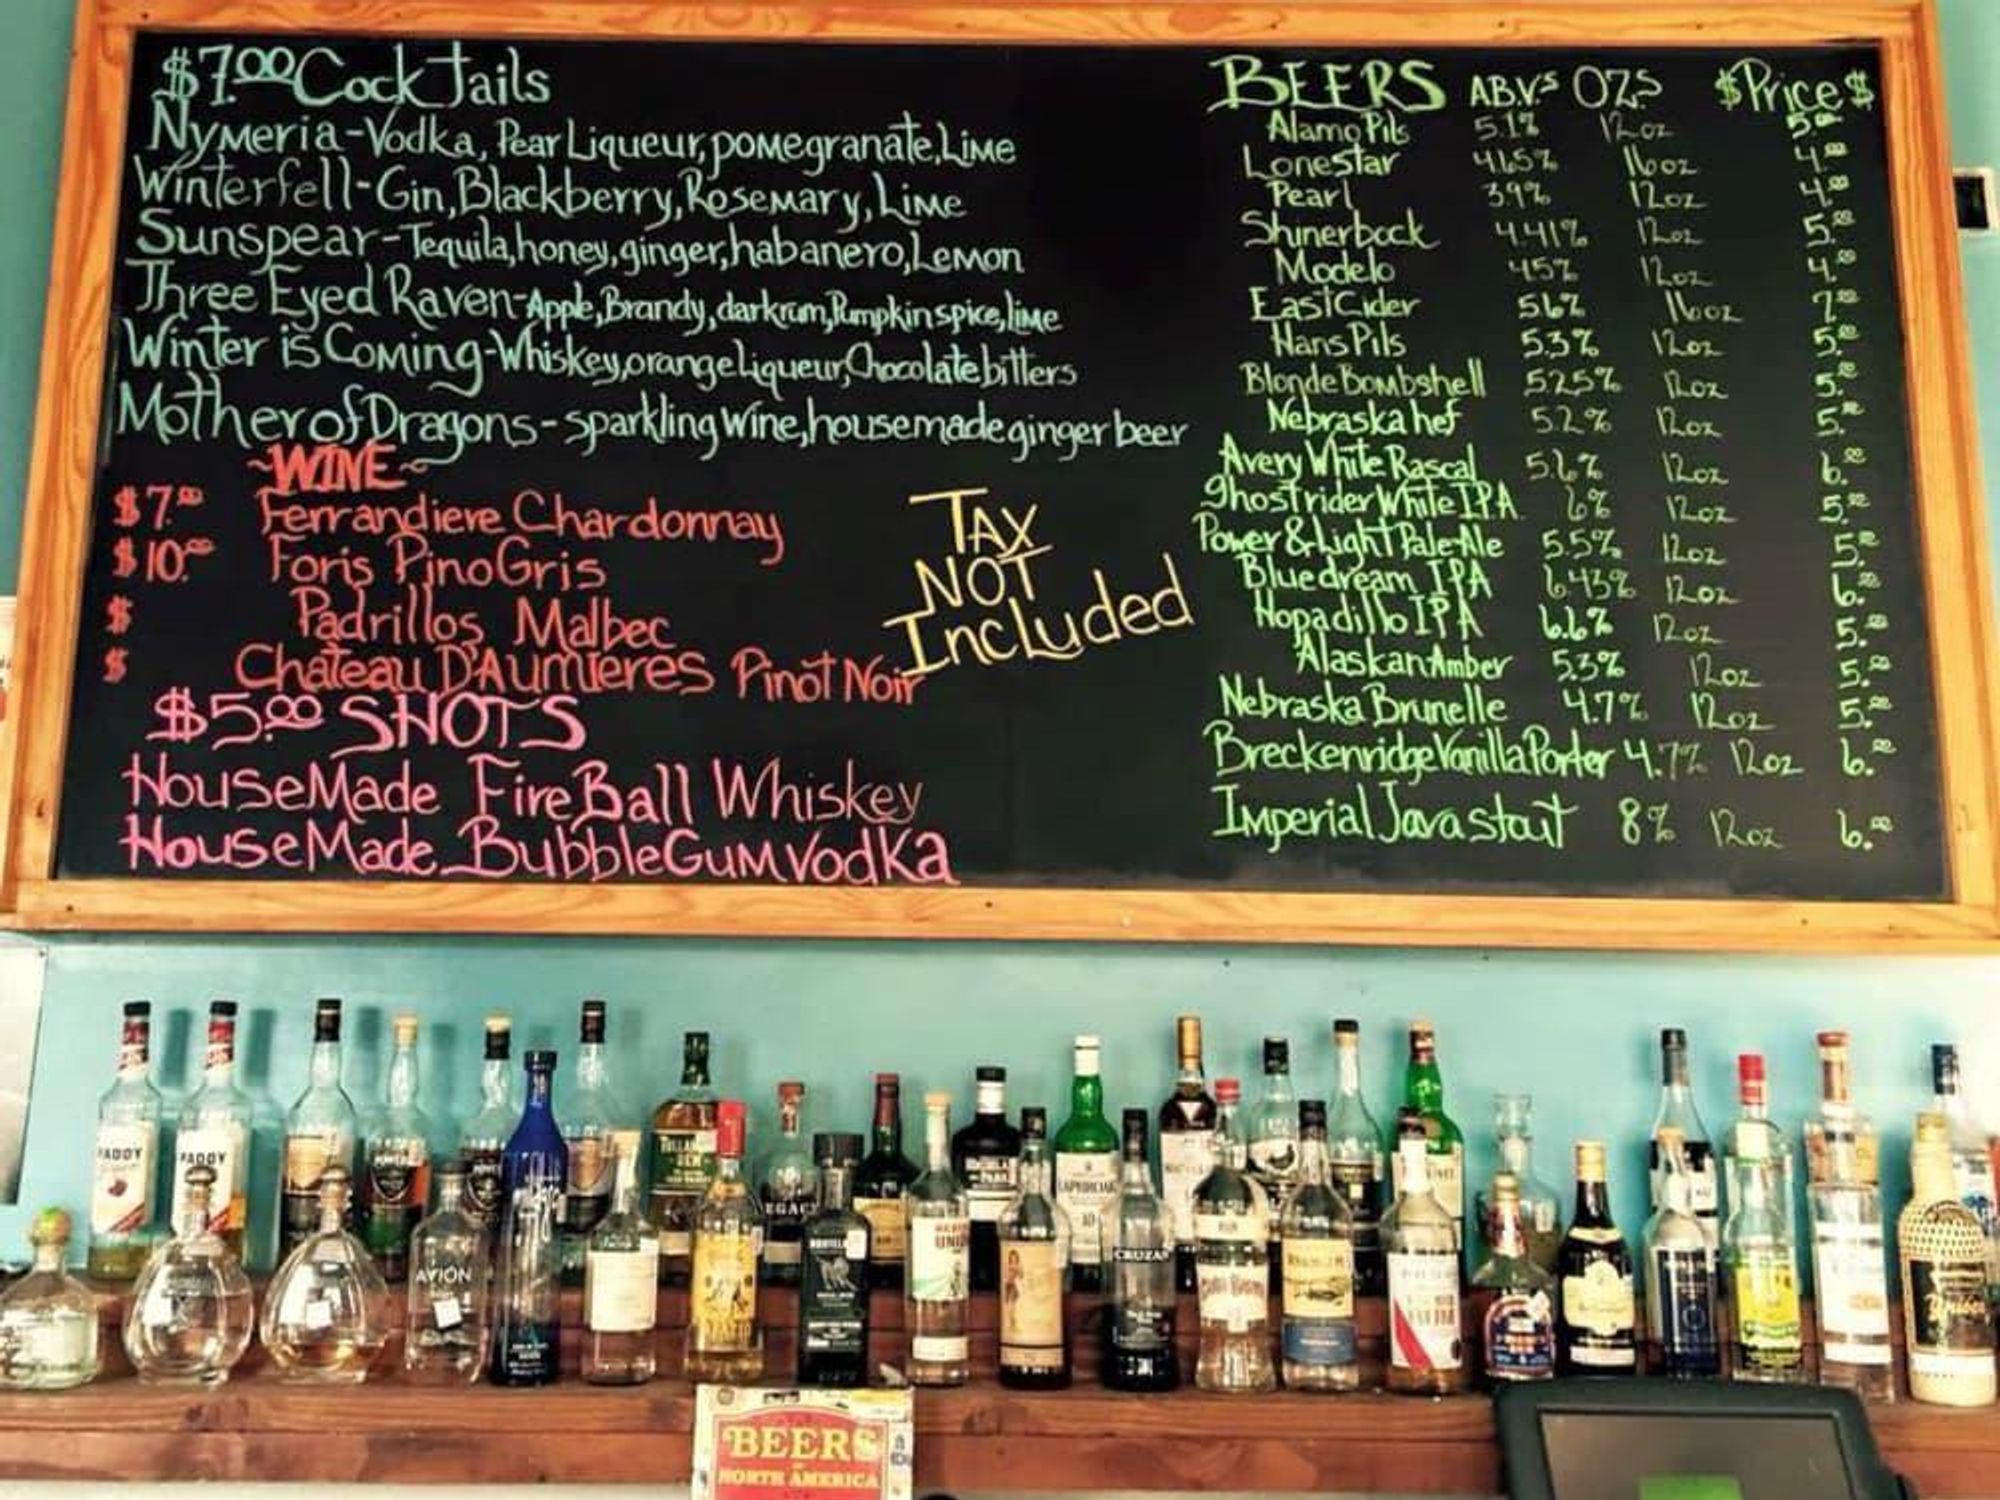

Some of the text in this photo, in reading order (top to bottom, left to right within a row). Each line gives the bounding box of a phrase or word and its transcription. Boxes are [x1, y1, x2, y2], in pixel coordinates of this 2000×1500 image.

[1206, 53, 1448, 112] BEERS
[497, 117, 561, 158] Pear
[1267, 109, 1361, 143] Alamo
[1364, 109, 1411, 145] Pils
[1243, 143, 1402, 178] Lonestar
[874, 172, 967, 224] Lime
[1266, 178, 1355, 211] Pearl
[1274, 246, 1396, 286] Modelo
[125, 259, 258, 318] Three
[267, 262, 380, 332] Eyed
[122, 318, 269, 369] Winter
[281, 326, 320, 369] is
[116, 372, 299, 447] Mother
[309, 384, 364, 441] of
[564, 391, 718, 460] sparkling
[1007, 420, 1109, 462] ginger
[1113, 410, 1189, 448] beer
[1266, 395, 1407, 434] Nebraska
[1410, 396, 1464, 436] hef
[1219, 432, 1302, 480] Avery
[1305, 431, 1386, 479] White
[1385, 442, 1478, 482] Rascal
[1377, 475, 1454, 519] White
[512, 491, 784, 564] Chardonnay
[1192, 511, 1282, 552] Power
[1284, 515, 1316, 557] &
[268, 535, 375, 587] Foris
[387, 535, 496, 588] Pino
[496, 535, 606, 591] Gris
[915, 544, 1054, 615] NOT
[290, 585, 675, 650] Padrillos Malbec
[235, 641, 427, 692] Chateau
[731, 647, 833, 703] Pinot
[844, 654, 926, 704] Noir
[1296, 631, 1430, 678] Alaskan
[1428, 643, 1513, 680] Amber
[329, 692, 587, 758] SHOTS
[1219, 673, 1363, 725] Nebraska
[1362, 680, 1508, 728] Brunelle
[712, 758, 924, 825] Whiskey
[1210, 782, 1375, 853] Imperial
[1378, 780, 1466, 844] Java
[416, 1266, 471, 1283] AVION
[722, 1426, 878, 1462] BEERS
